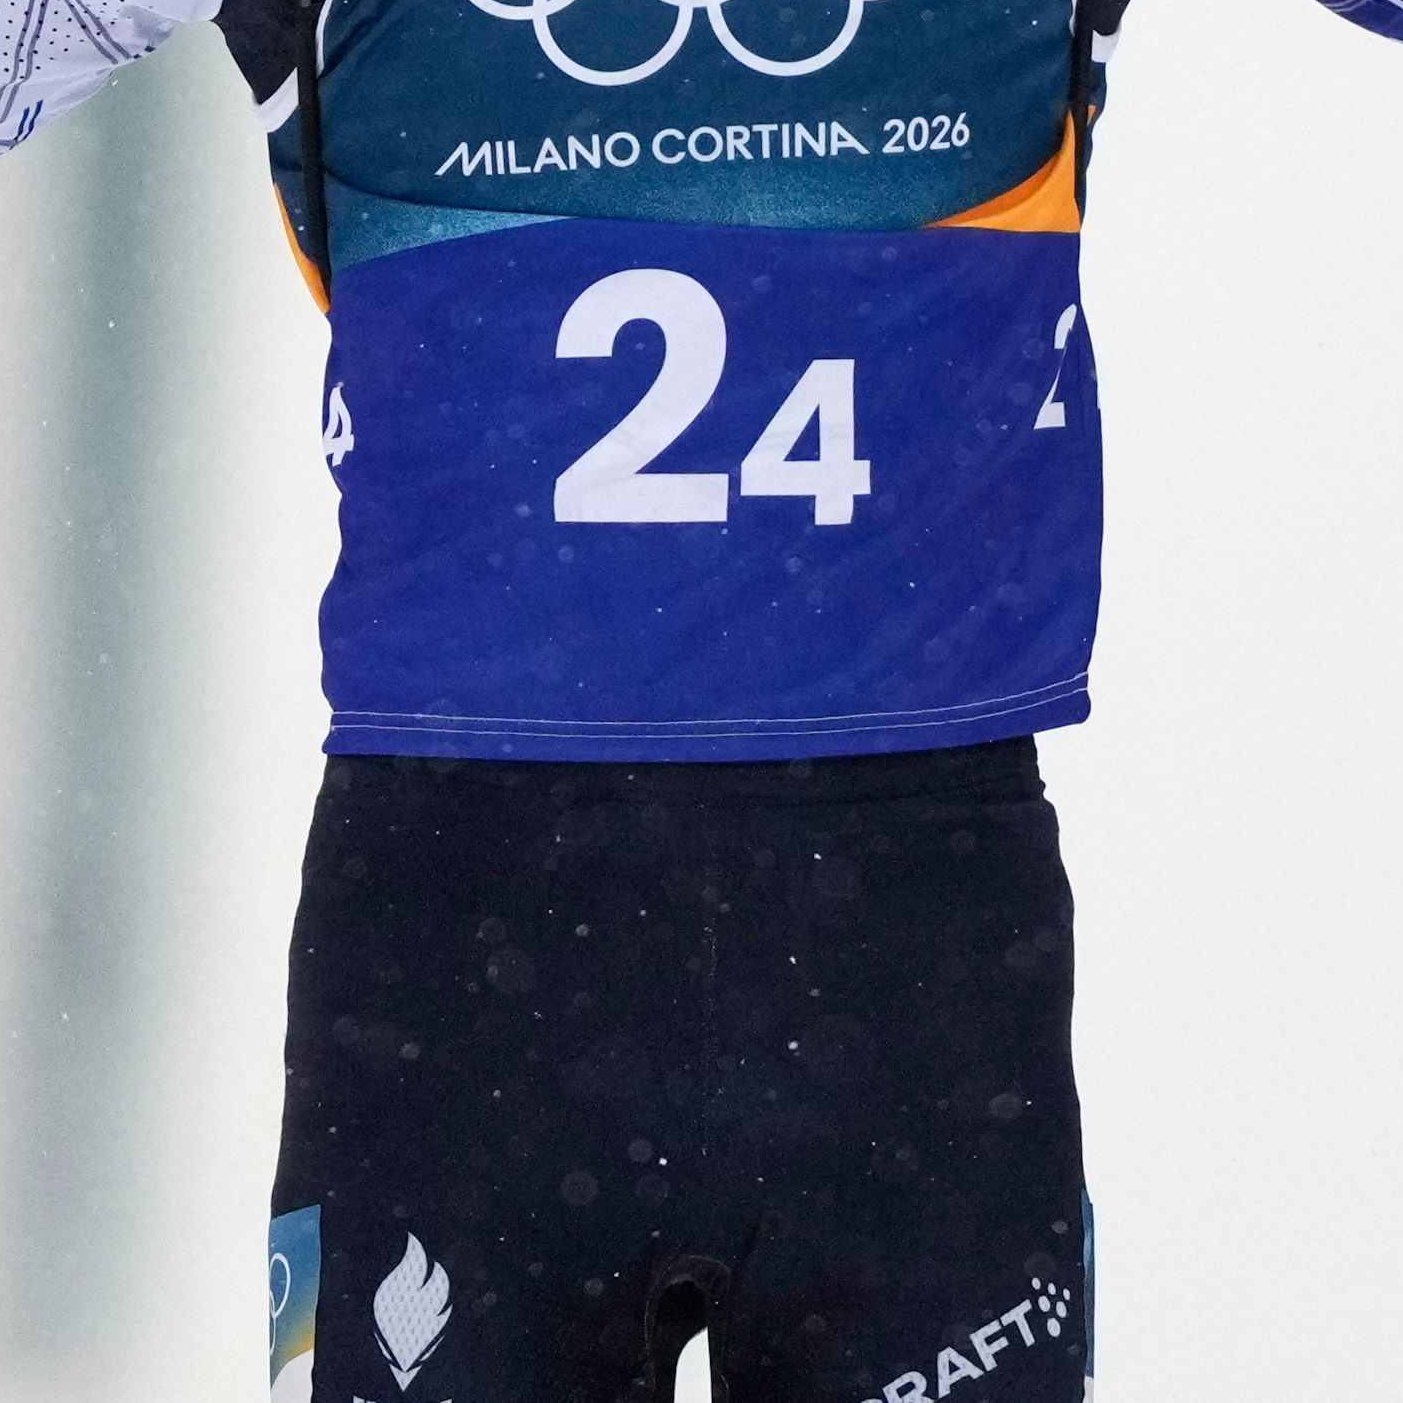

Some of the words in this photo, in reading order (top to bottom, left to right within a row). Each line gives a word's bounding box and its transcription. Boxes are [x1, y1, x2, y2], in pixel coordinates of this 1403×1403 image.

[434, 130, 640, 177] MILANO
[651, 120, 871, 165] CORTINA
[882, 111, 971, 154] 2026
[554, 267, 872, 525] 24
[861, 1298, 1033, 1403] RAFT
